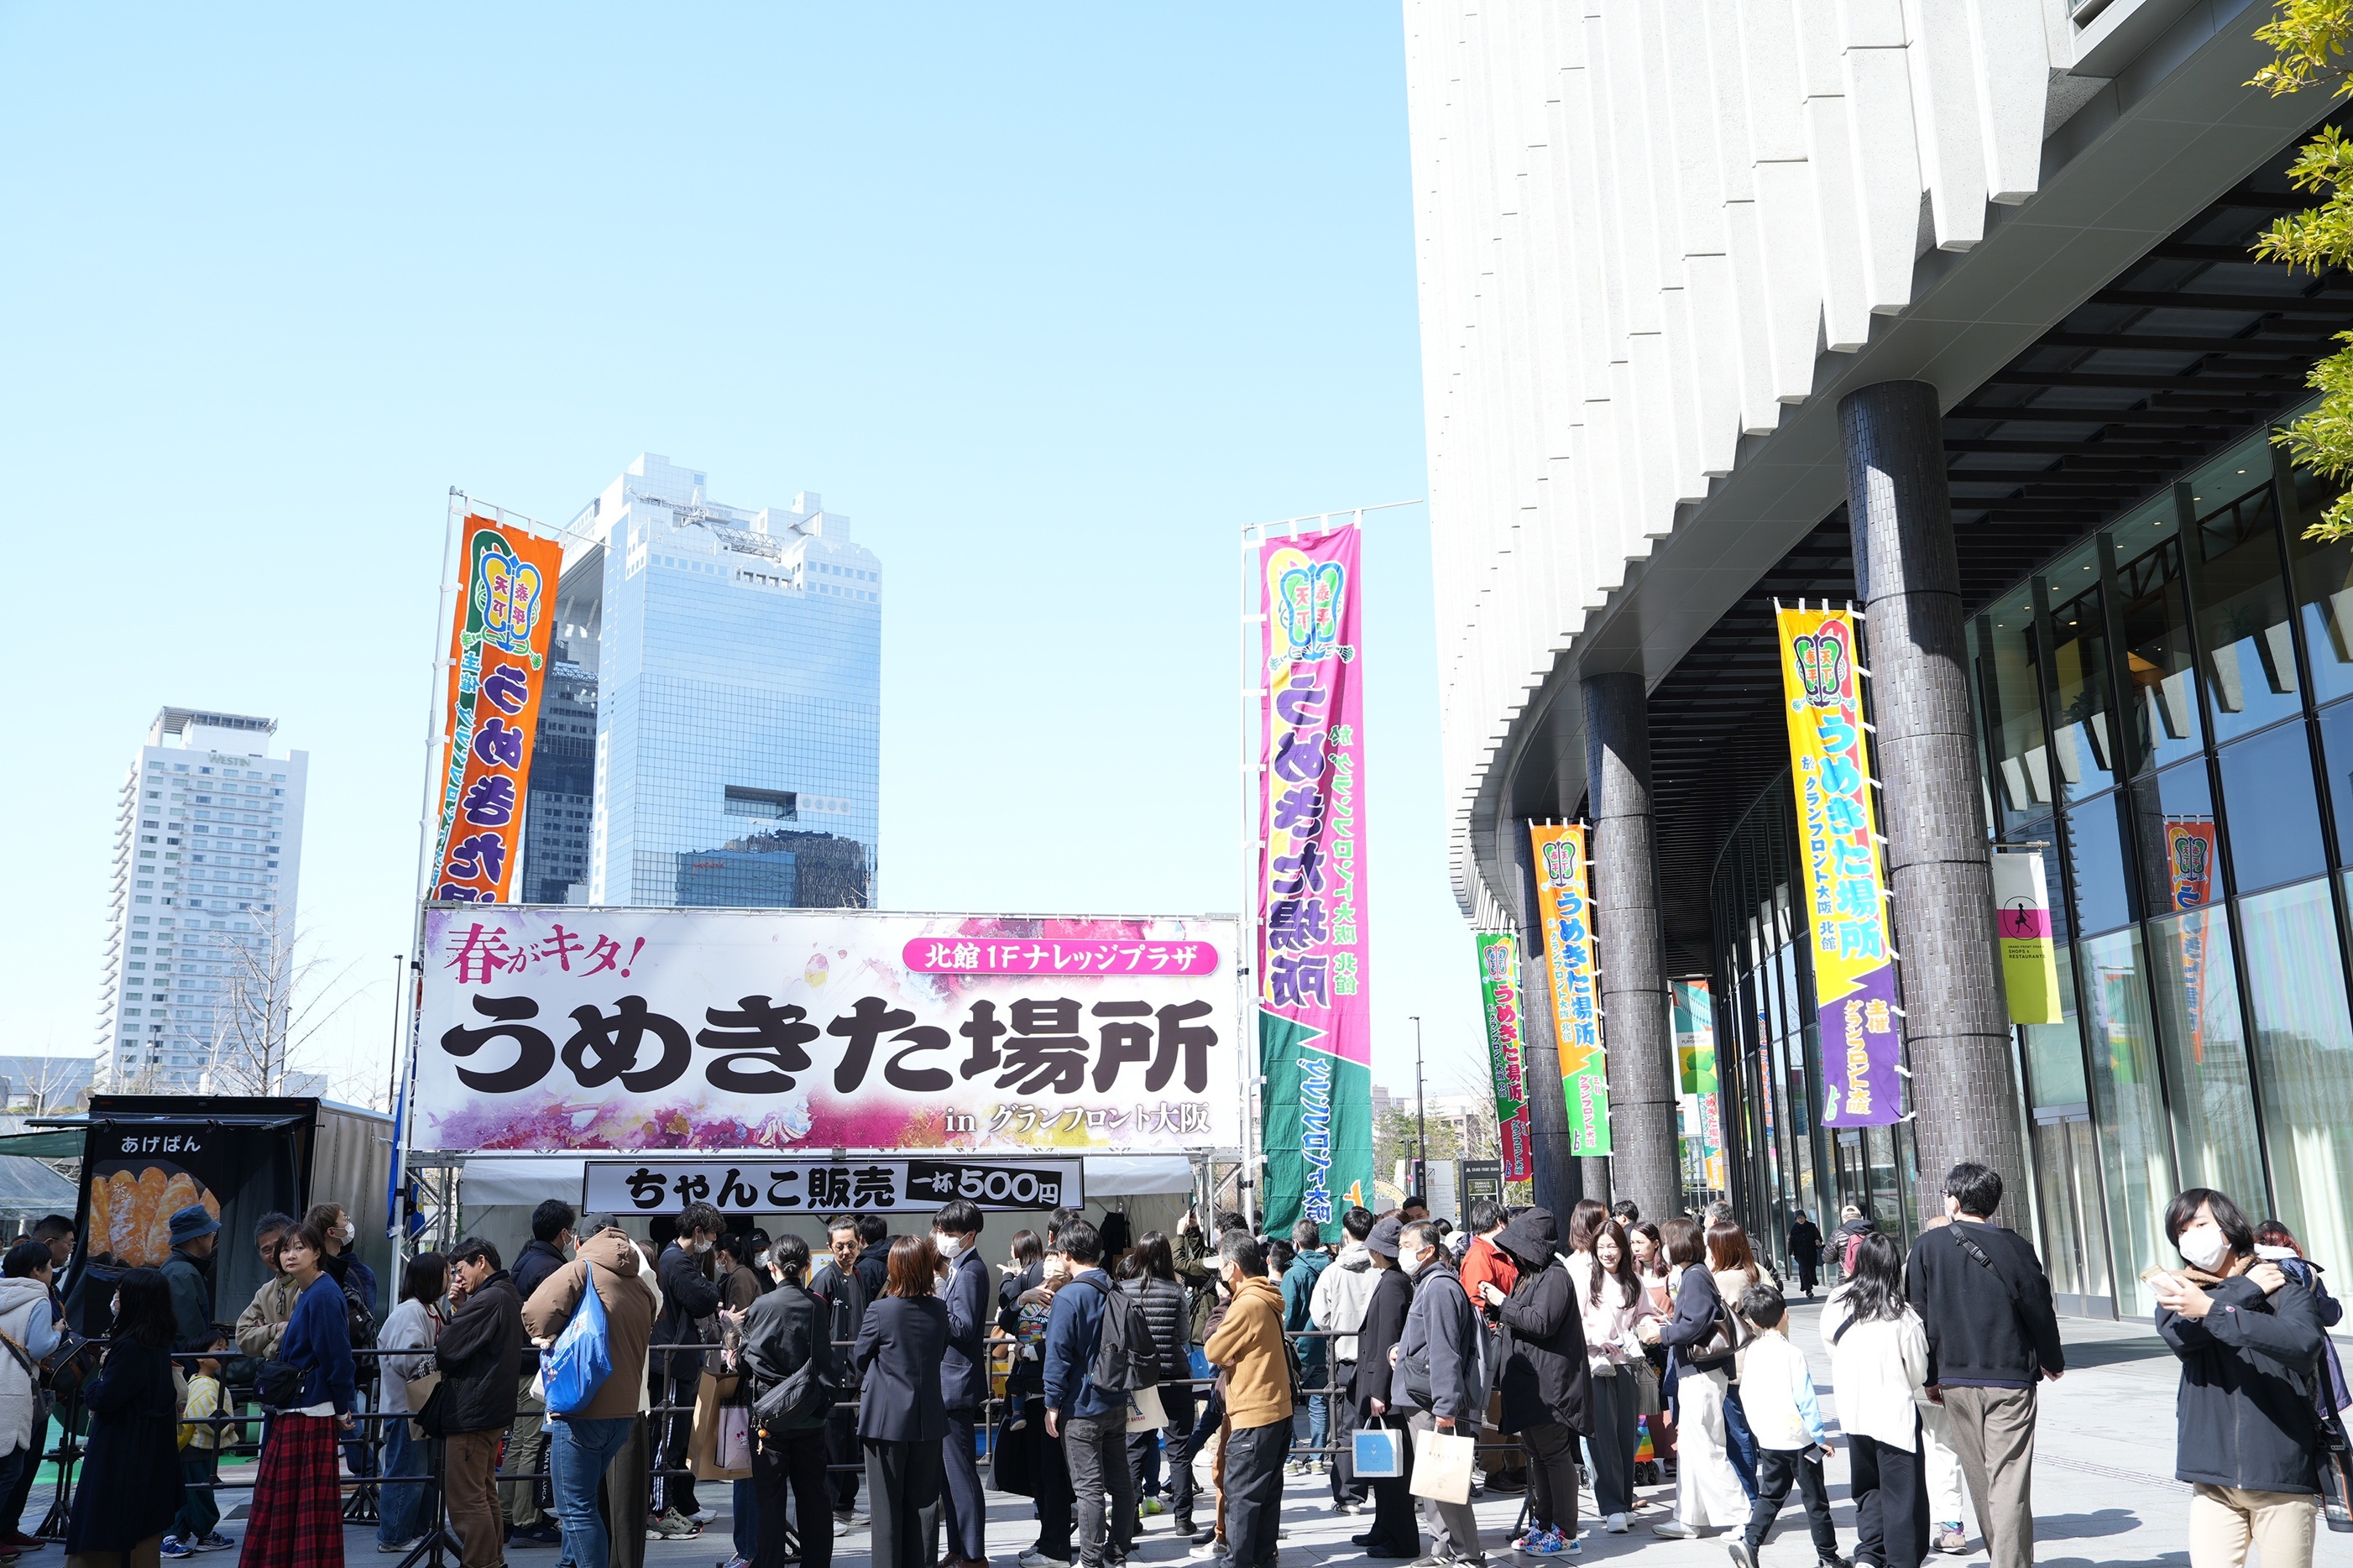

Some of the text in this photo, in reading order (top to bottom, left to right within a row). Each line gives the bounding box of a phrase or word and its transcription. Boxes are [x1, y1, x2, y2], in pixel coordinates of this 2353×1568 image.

[1804, 649, 1818, 682] 泰平
[1820, 649, 1833, 683] 天下
[207, 753, 251, 766] WESTIN
[1817, 714, 1882, 960] うめきた場所
[1804, 776, 1833, 914] グランフロント大阪
[1819, 921, 1837, 951] 北館
[1557, 892, 1595, 1047] うめきた場所
[1864, 998, 1890, 1033] 主催
[441, 991, 1219, 1095] うめきた場所
[1494, 985, 1524, 1102] うめきた場所
[1844, 999, 1872, 1115] グランフロント大阪
[945, 1101, 1212, 1133] in グランフロント大阪
[121, 1135, 201, 1153] あげぱん
[625, 1166, 896, 1209] ちゃんこ販売
[543, 1444, 552, 1463] DEAN
